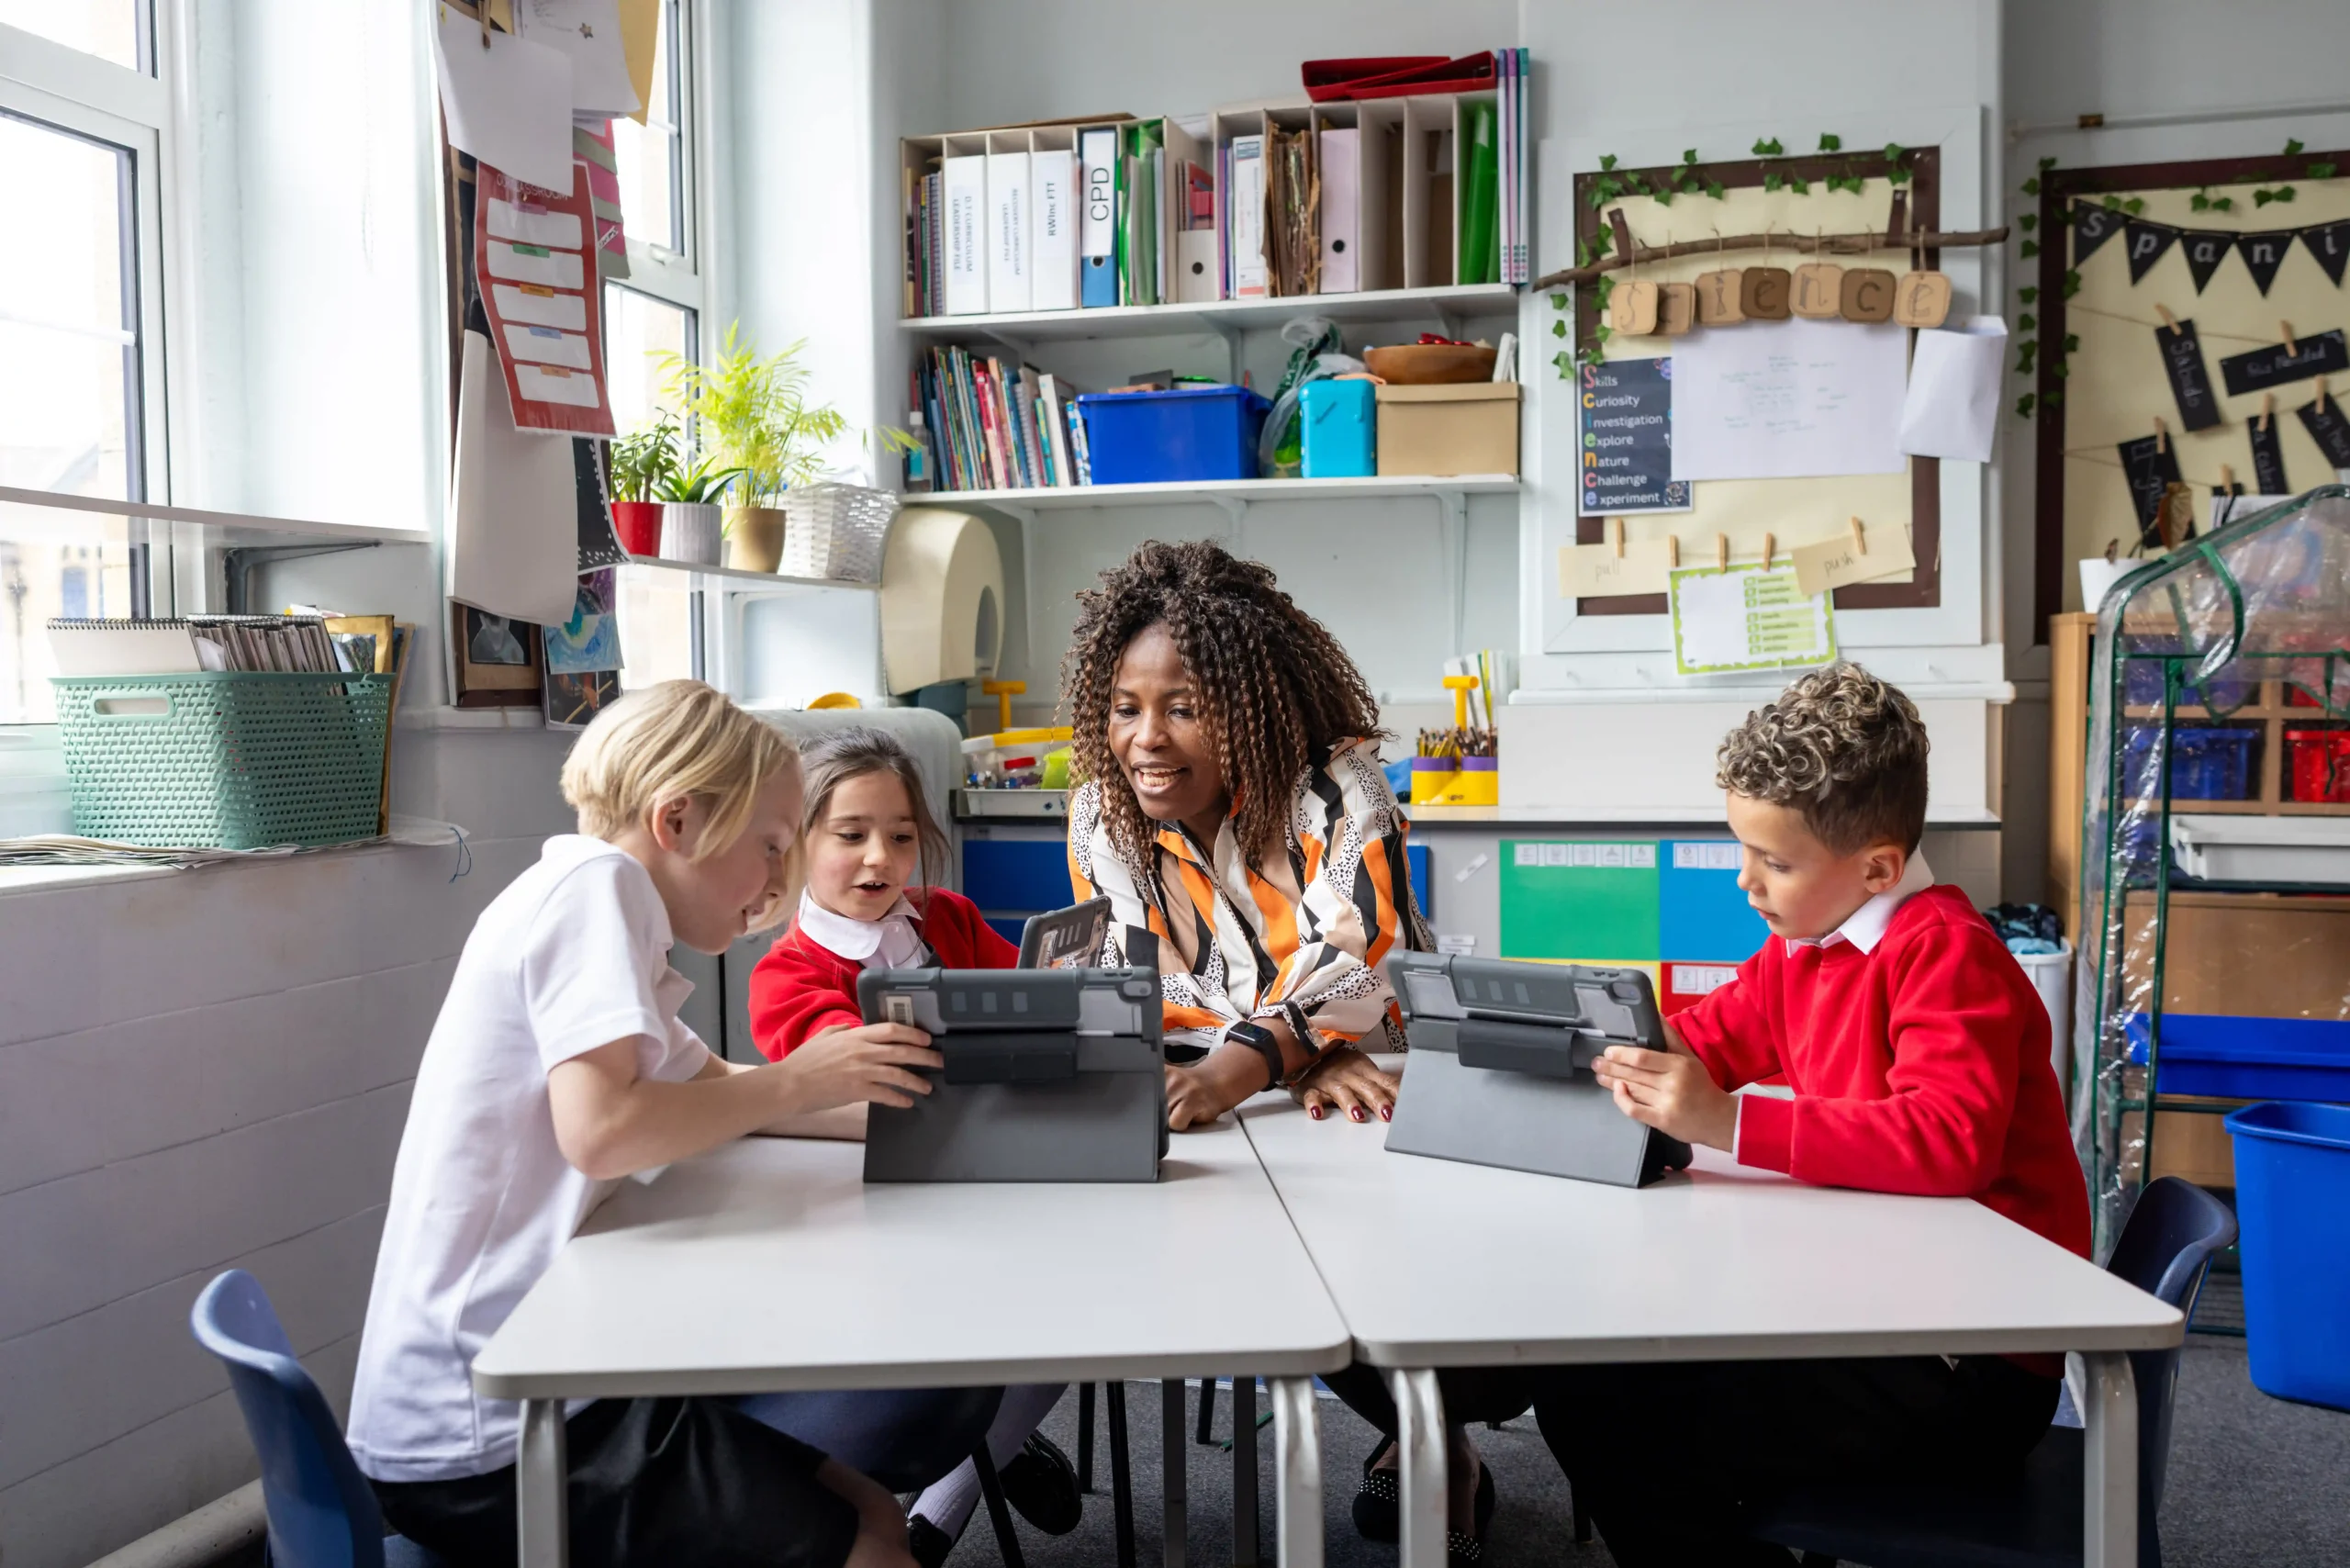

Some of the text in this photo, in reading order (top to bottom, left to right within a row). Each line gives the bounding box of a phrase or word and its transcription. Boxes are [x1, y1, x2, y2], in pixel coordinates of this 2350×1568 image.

[1091, 167, 1109, 221] CPD
[953, 198, 962, 271] LEADERSHIP FILE
[965, 212, 973, 272] CURRICULUM
[1584, 364, 1618, 388] Skills
[1585, 411, 1663, 429] investigation
[1584, 432, 1634, 449] explore
[1584, 452, 1630, 468] nature
[1595, 558, 1620, 580] pull
[1823, 552, 1854, 577] push
